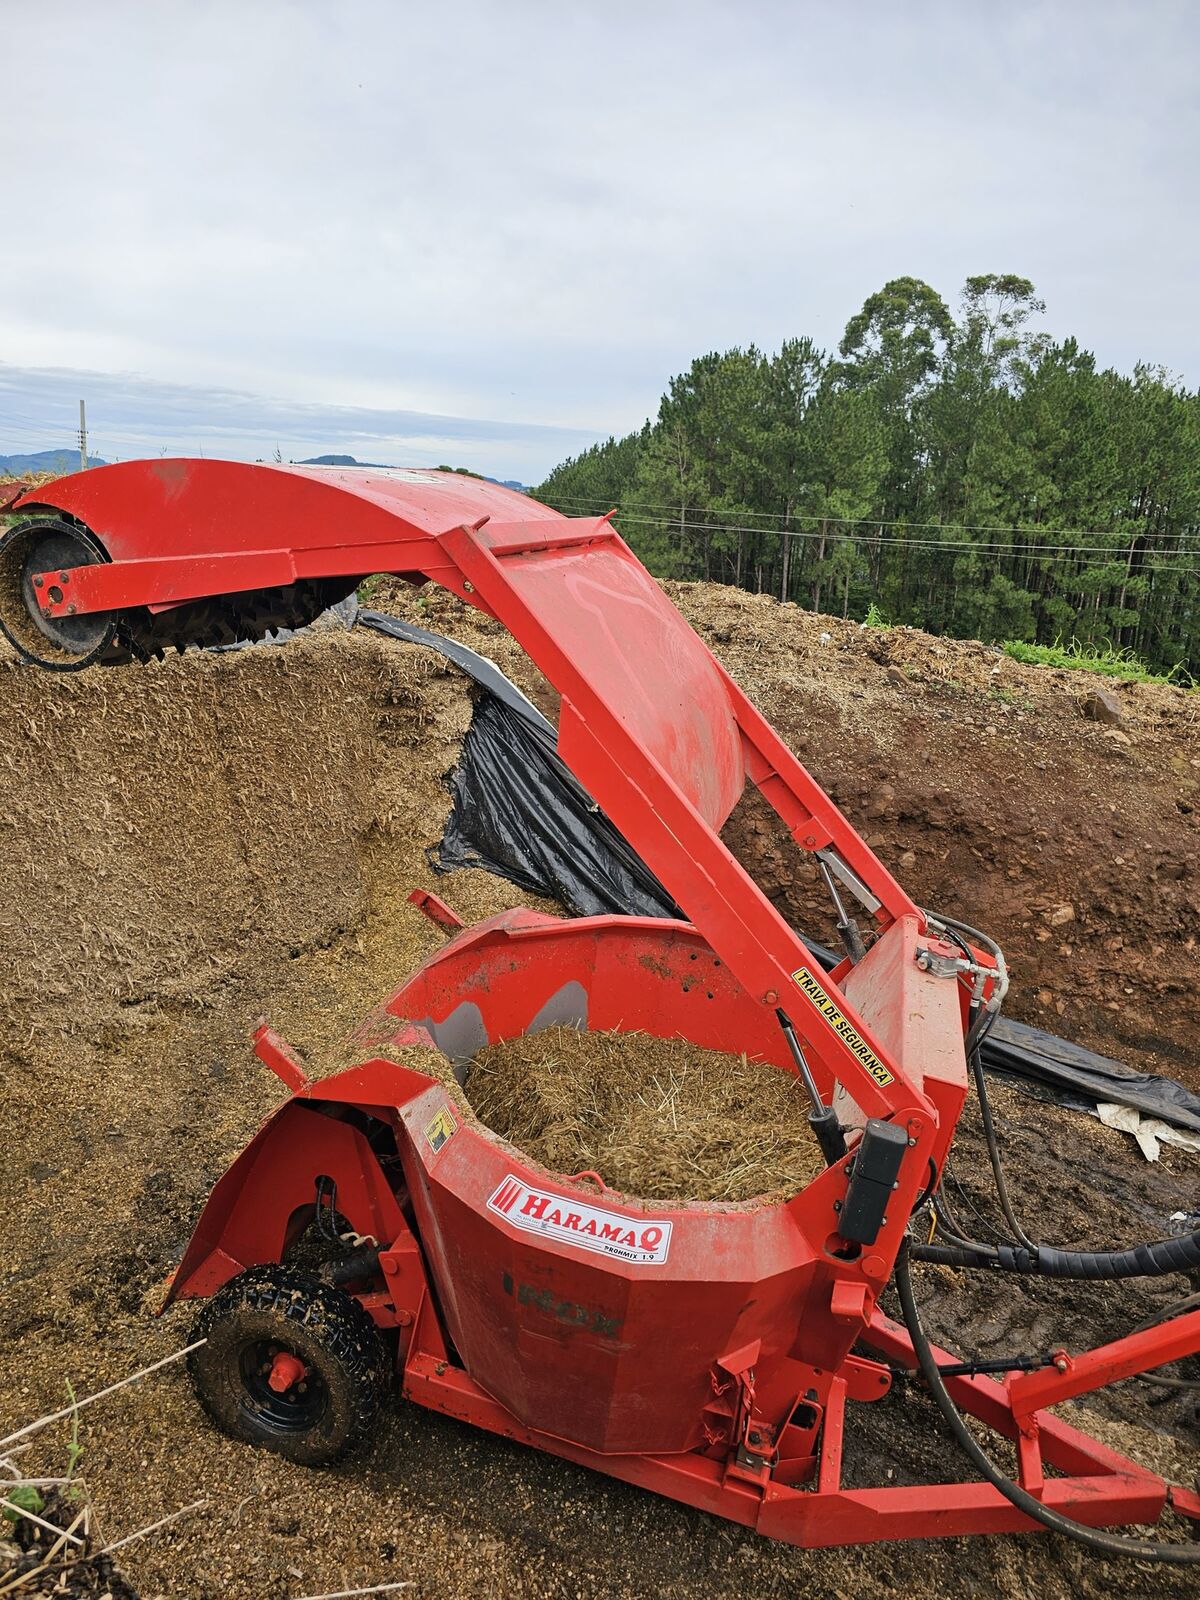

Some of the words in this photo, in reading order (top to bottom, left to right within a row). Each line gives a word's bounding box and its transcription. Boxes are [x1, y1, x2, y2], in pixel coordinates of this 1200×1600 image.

[798, 972, 828, 1008] TRAVA
[824, 1006, 840, 1022] DE
[836, 1021, 889, 1083] SEGURANÇA
[520, 1194, 663, 1251] HARAMAQ
[604, 1245, 637, 1260] PROHMIX
